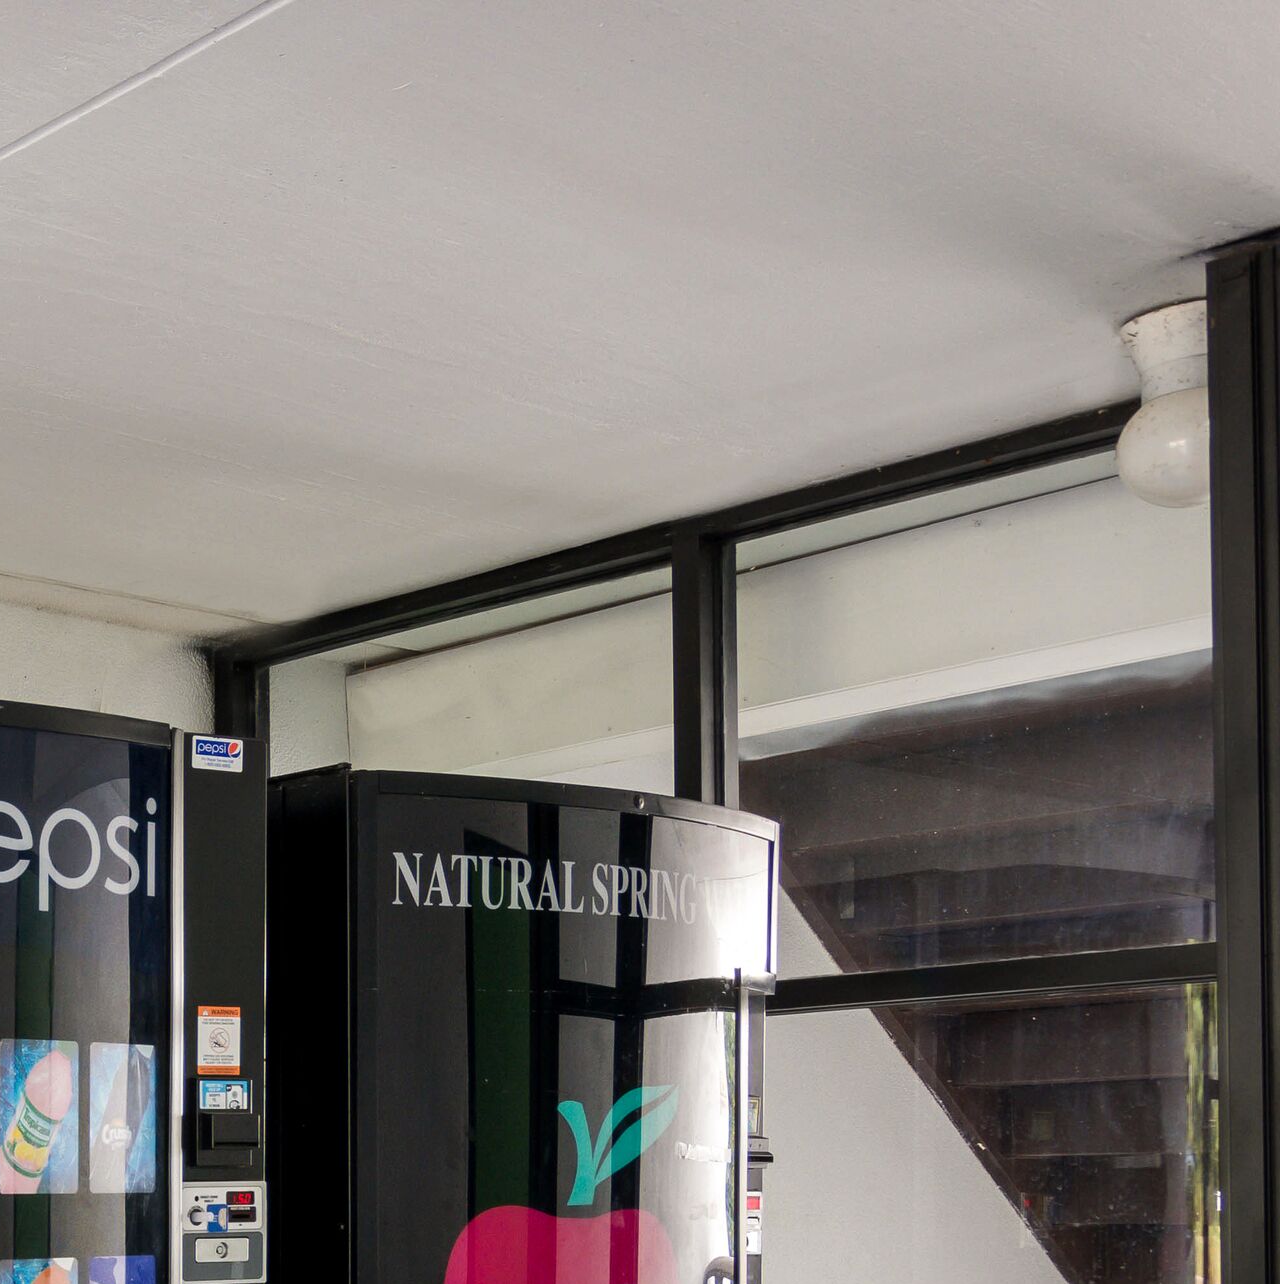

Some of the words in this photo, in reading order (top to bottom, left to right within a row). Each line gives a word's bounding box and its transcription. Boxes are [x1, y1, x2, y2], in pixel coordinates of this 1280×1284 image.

[197, 743, 227, 755] pepsi
[392, 851, 586, 914] NATURAL
[592, 862, 697, 925] SPRING
